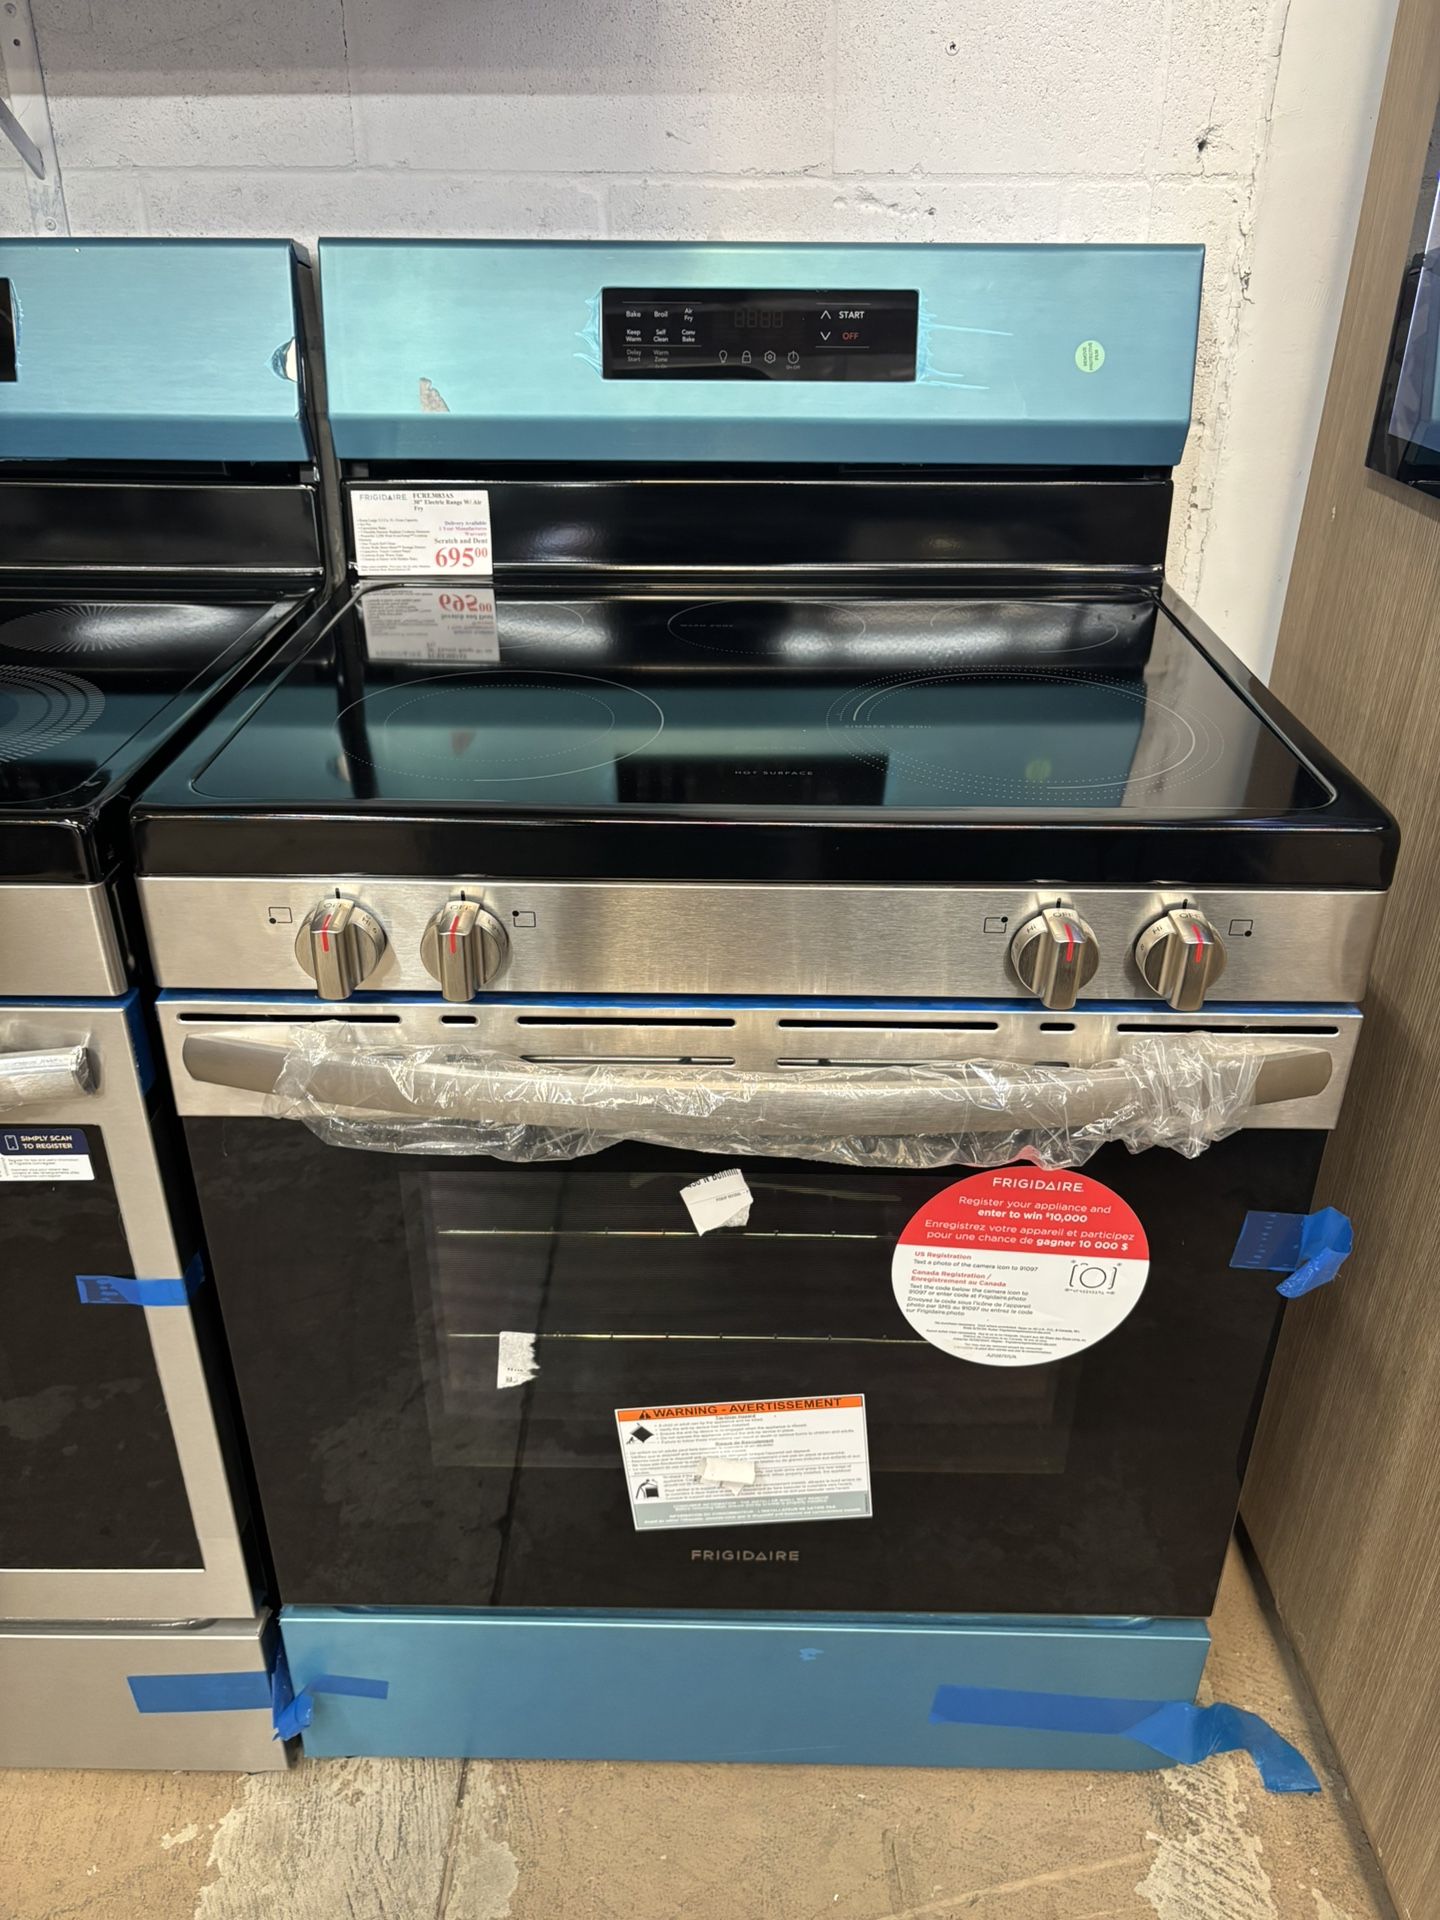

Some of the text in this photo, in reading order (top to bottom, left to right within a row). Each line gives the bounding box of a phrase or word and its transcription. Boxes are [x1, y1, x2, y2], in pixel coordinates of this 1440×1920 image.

[839, 311, 864, 319] START
[842, 332, 859, 340] OFF
[992, 1177, 1084, 1192] FRIGIDAIRE
[959, 1196, 1111, 1214] Register your appliance and
[977, 1209, 1088, 1223] enter to win $10,000
[925, 1219, 986, 1231] Enregistrez
[989, 1225, 1017, 1233] votre
[1020, 1226, 1064, 1236] appareil
[1080, 1231, 1135, 1241] participez
[927, 1231, 952, 1239] pour
[978, 1233, 1017, 1243] chance
[1019, 1236, 1033, 1245] de
[1036, 1238, 1076, 1247] gagner
[1079, 1240, 1091, 1248] 10
[1094, 1241, 1118, 1250] 000
[1121, 1242, 1129, 1251] $
[927, 1252, 972, 1260] Registration
[911, 1275, 967, 1284] Enregistrement
[941, 1271, 986, 1279] Registration
[653, 1405, 718, 1418] WARNING
[729, 1398, 842, 1413] AVERTISSEMENT
[691, 1549, 800, 1561] FRIGIDAIRE
